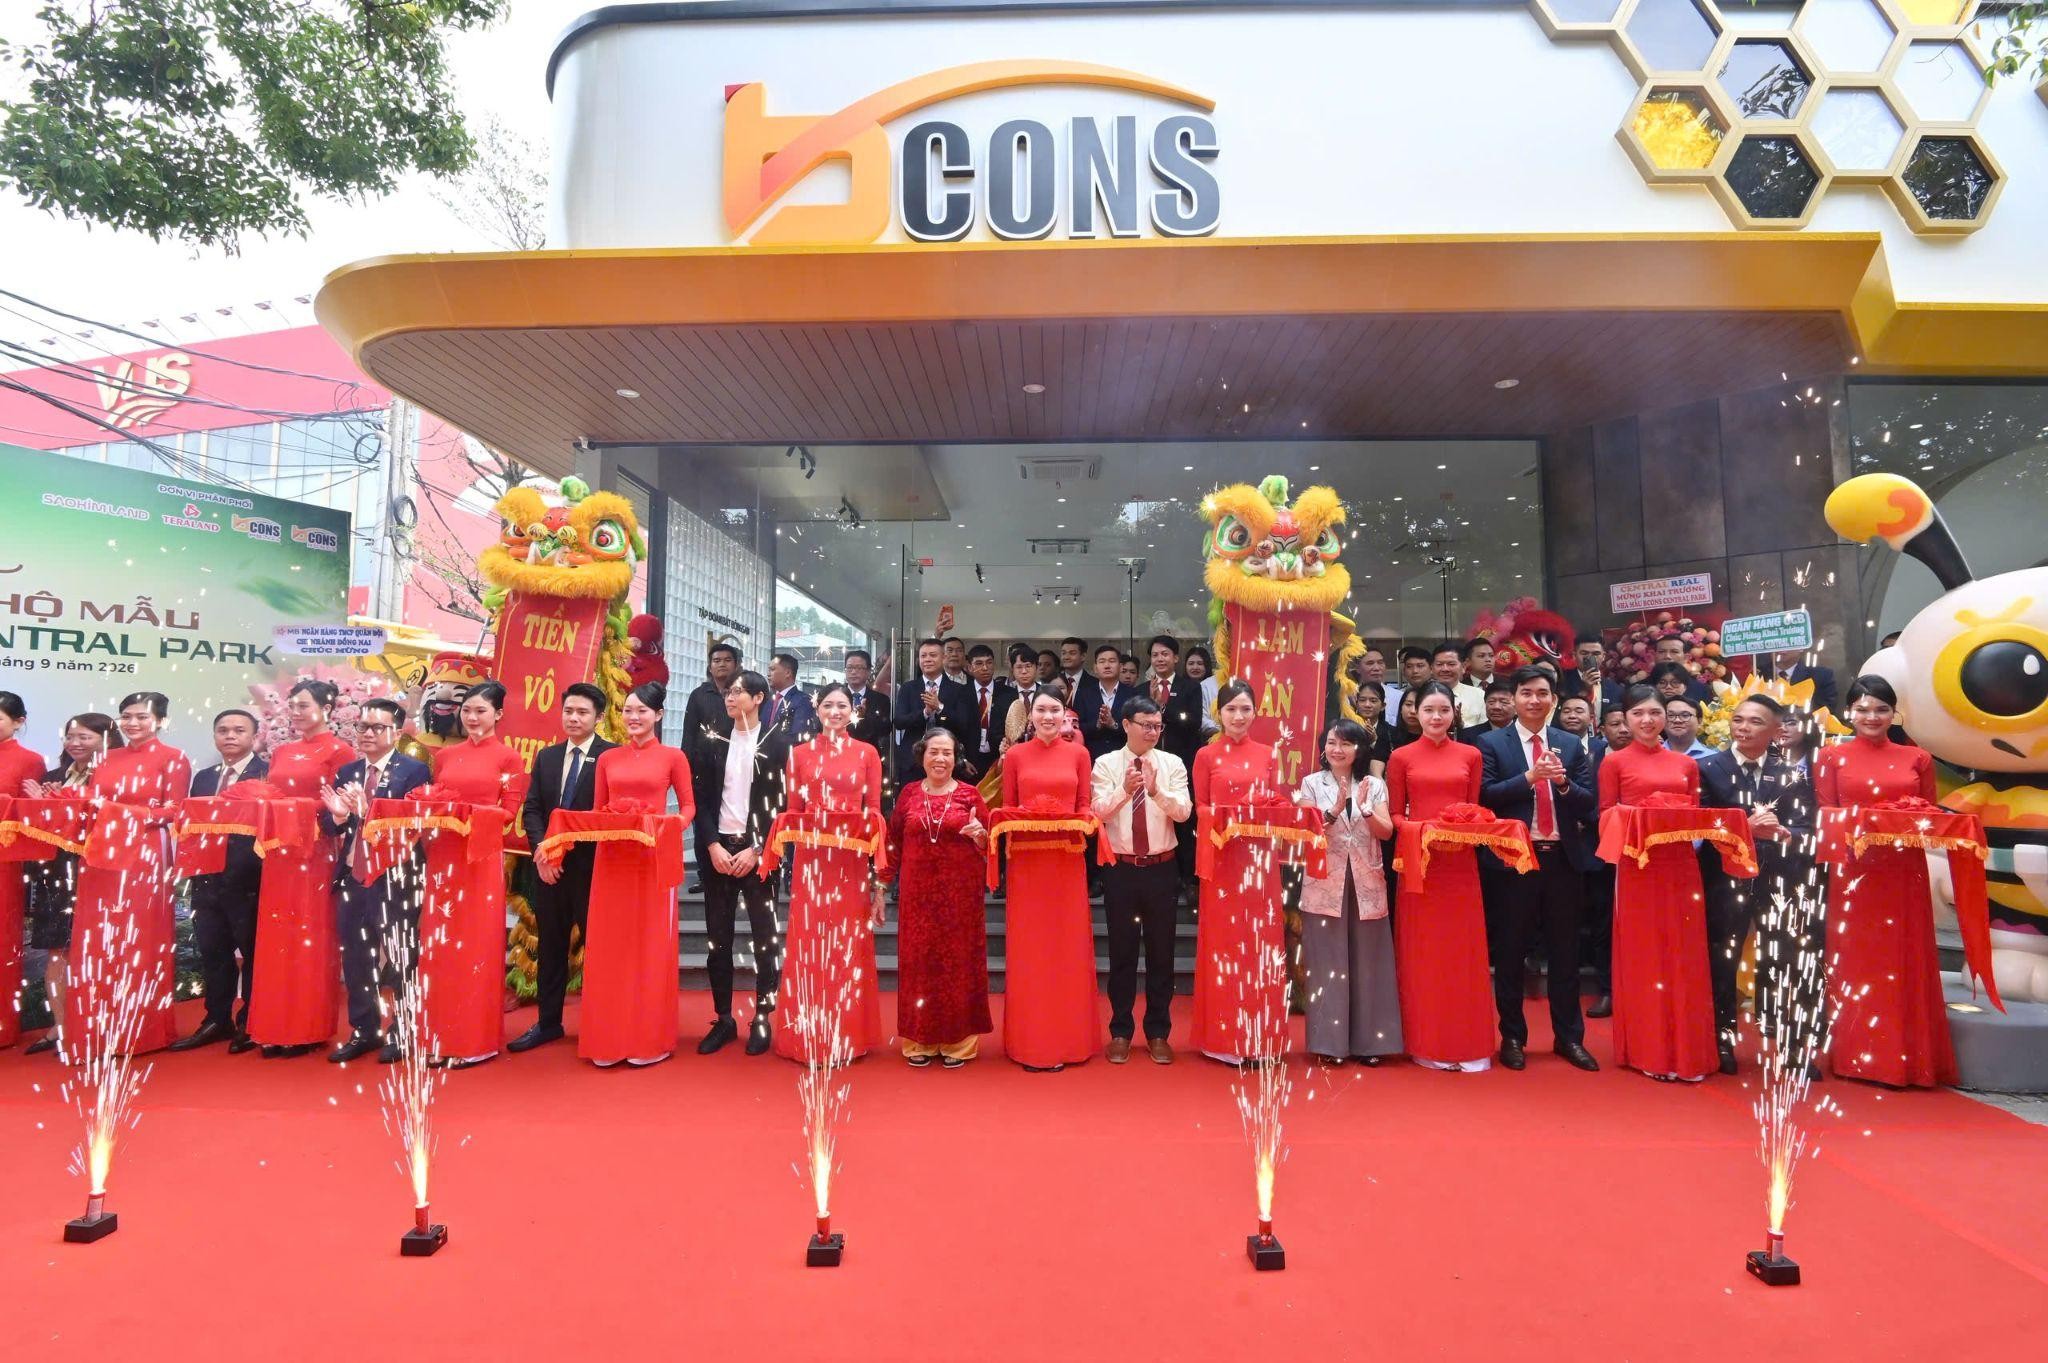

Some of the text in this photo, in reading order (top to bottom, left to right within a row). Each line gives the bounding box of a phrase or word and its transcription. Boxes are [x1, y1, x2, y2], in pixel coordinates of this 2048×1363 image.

[163, 516, 220, 532] TERALAND
[1620, 577, 1700, 593] CENTRAL REAL
[1663, 595, 1690, 604] CENTRAL
[80, 595, 200, 630] MẪU
[160, 637, 274, 665] PARK
[41, 658, 51, 669] 9
[57, 660, 93, 671] năm
[98, 662, 136, 674] 2026
[524, 667, 555, 713] VÔ
[1257, 671, 1295, 719] ĂN
